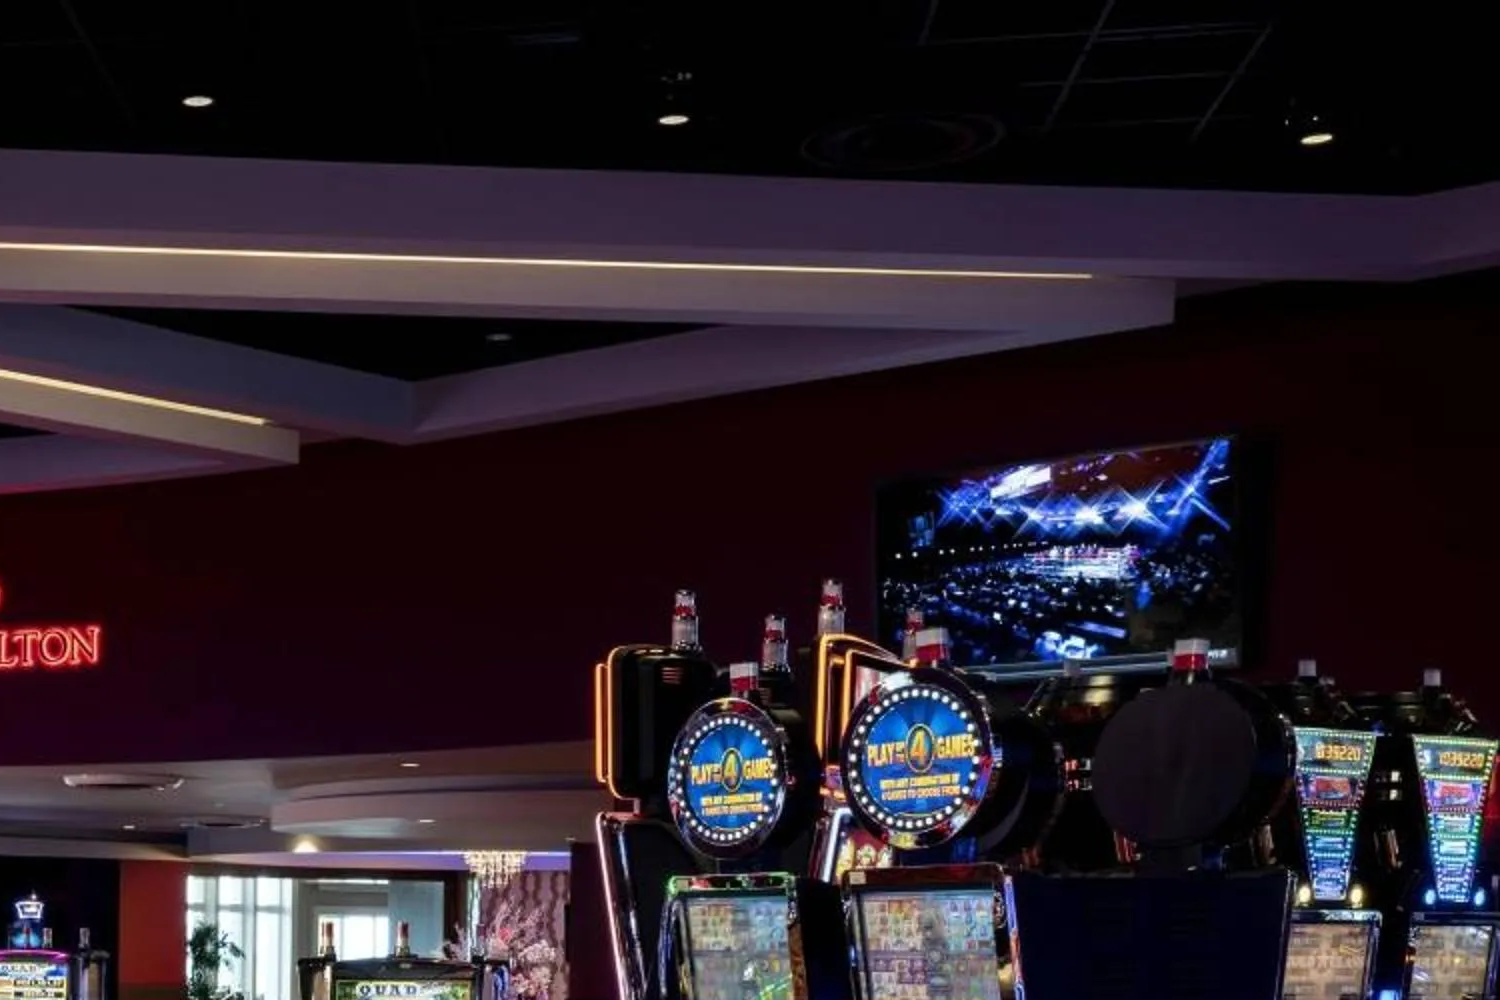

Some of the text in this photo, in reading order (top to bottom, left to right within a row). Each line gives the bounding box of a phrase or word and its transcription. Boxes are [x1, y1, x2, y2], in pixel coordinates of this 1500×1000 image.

[909, 728, 926, 768] 4
[937, 733, 975, 759] GAMES
[724, 752, 737, 786] 4
